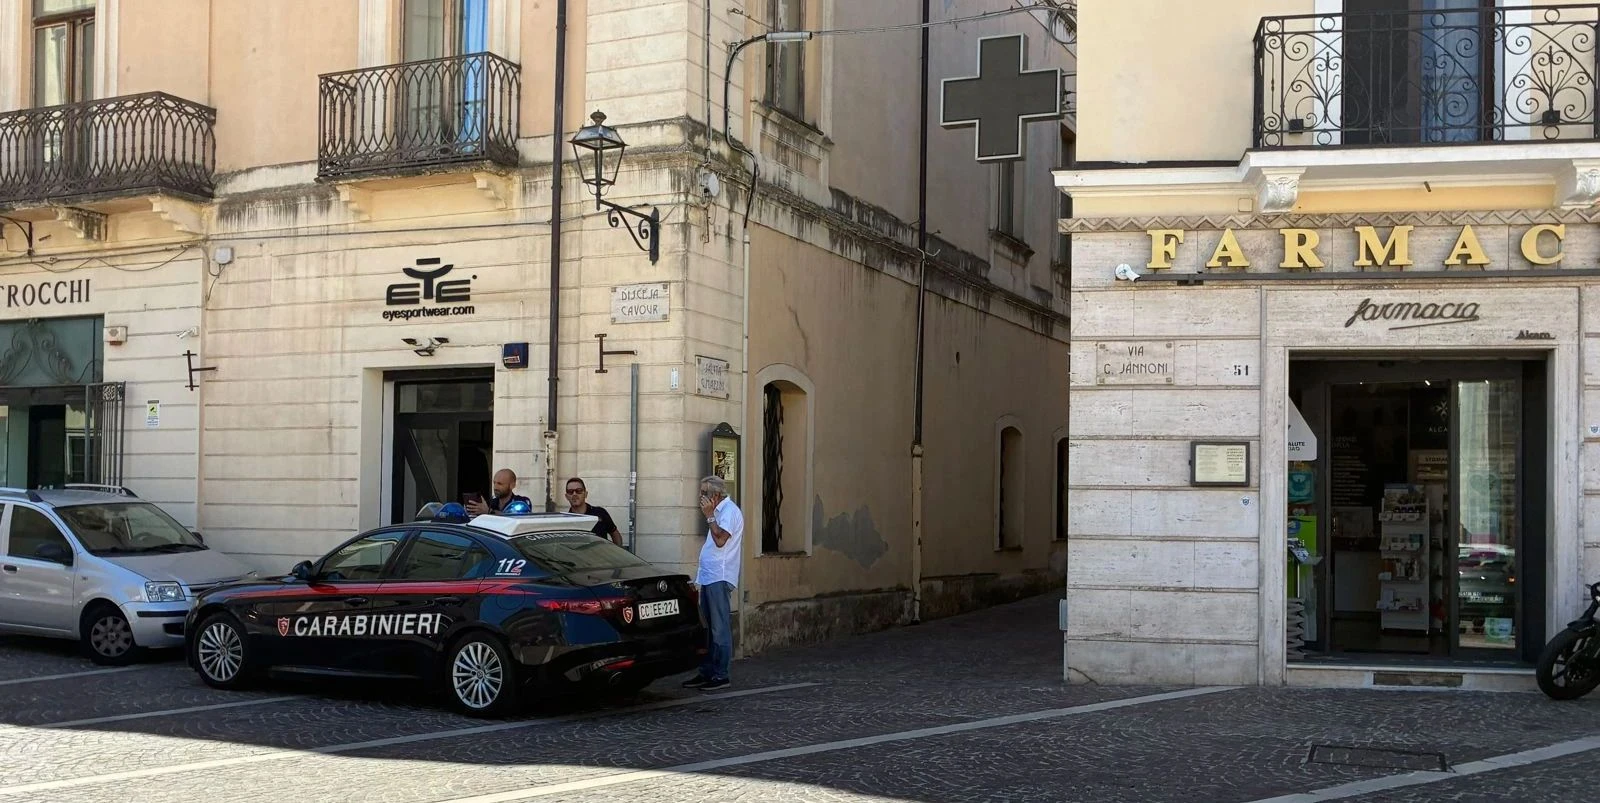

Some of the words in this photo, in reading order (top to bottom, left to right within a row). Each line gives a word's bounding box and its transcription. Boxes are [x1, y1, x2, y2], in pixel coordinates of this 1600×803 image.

[382, 305, 475, 321] eyesportwear.com
[621, 304, 658, 316] CAVOUR
[1345, 298, 1480, 328] farmacia
[1128, 346, 1144, 357] VIA
[1119, 362, 1168, 375] JANNONI
[1234, 364, 1249, 376] 51
[496, 558, 527, 573] 112
[640, 605, 650, 618] CC
[294, 614, 441, 636] CARABINIERI
